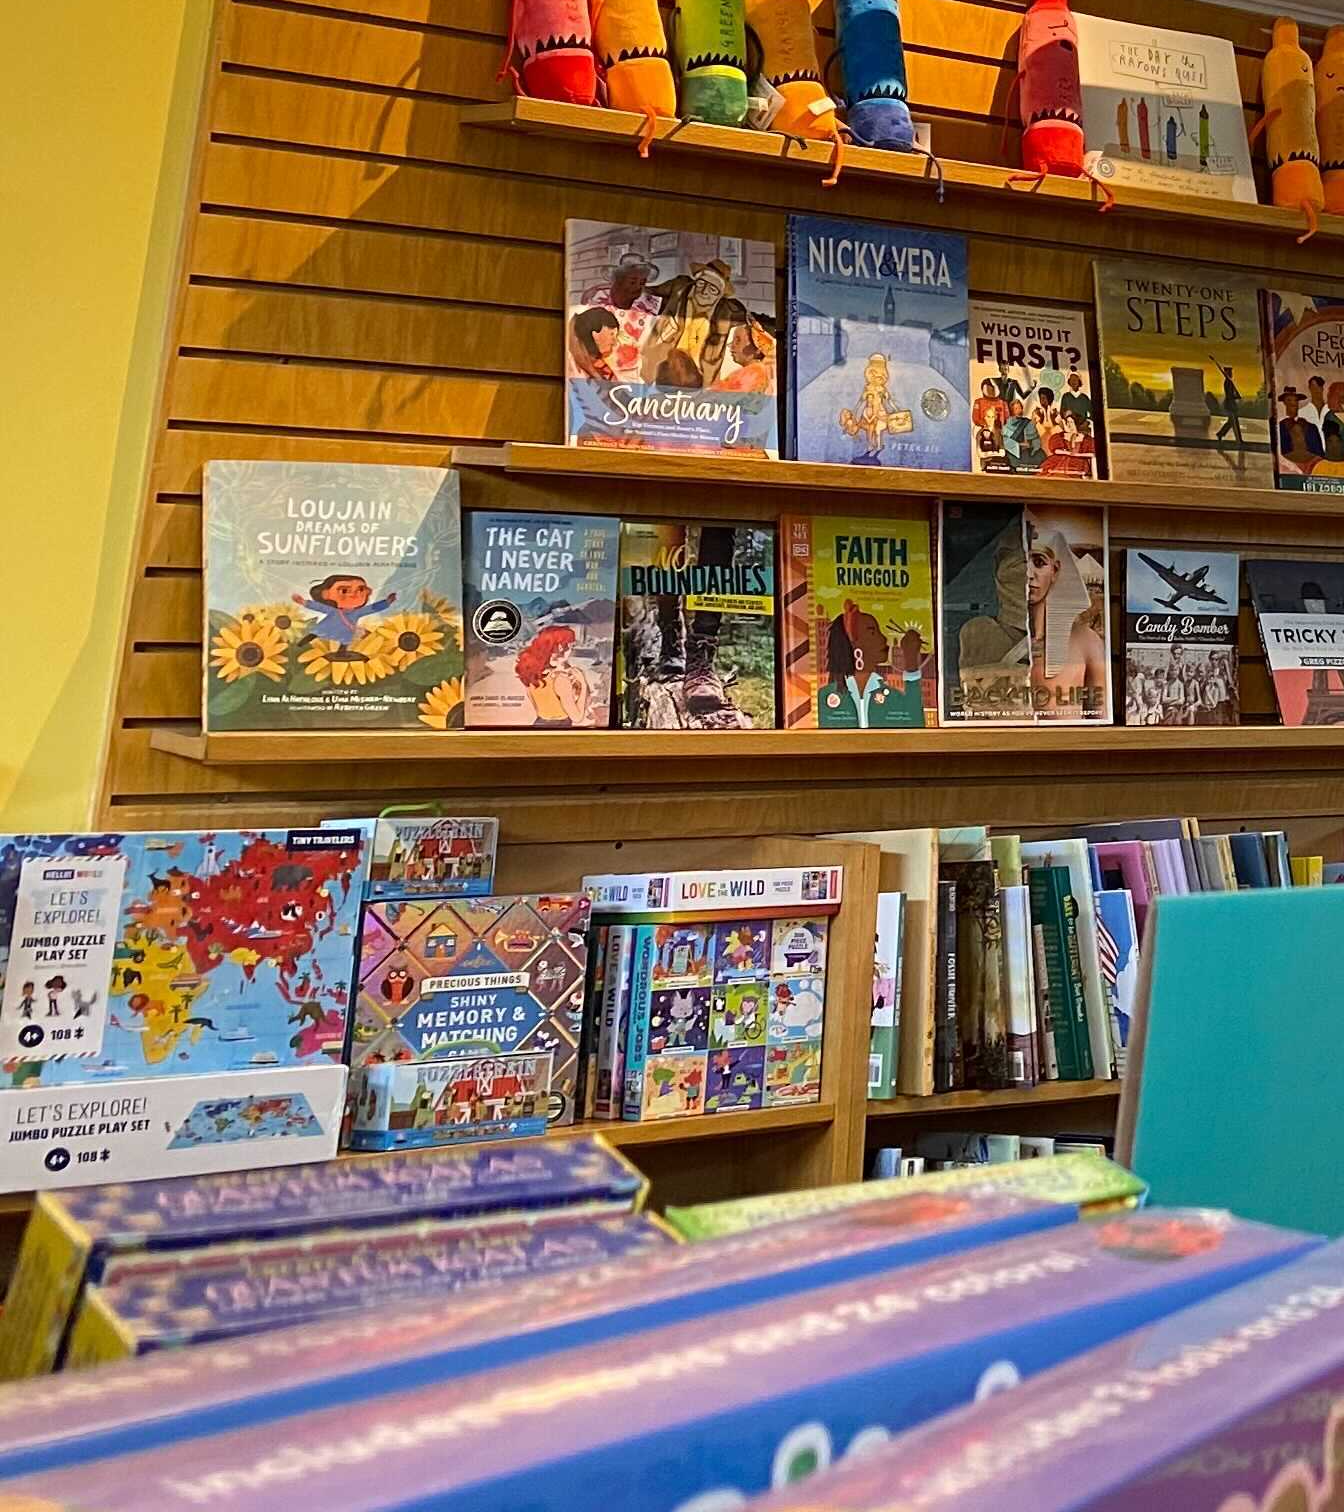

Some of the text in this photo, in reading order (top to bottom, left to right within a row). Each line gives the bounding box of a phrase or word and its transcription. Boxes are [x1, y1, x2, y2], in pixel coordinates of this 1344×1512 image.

[720, 0, 736, 49] GREEN
[808, 235, 885, 280] NICKY
[892, 245, 953, 289] VERA
[1124, 279, 1234, 303] TWENTY-ONE
[1126, 296, 1238, 342] STEPS
[981, 321, 1072, 343] WHO DID IT
[976, 338, 1082, 371] FIRST?
[603, 384, 745, 444] Sanctuary
[286, 497, 392, 521] LOUJAIN
[295, 521, 379, 534] DREAMS OF
[486, 527, 576, 549] THE CAT
[257, 531, 420, 558] SUNFLOWERS
[834, 535, 909, 566] FAITH
[485, 550, 574, 573] I NEVER
[481, 571, 560, 593] NAMED
[630, 564, 767, 596] BOUNDARIES
[836, 567, 911, 588] RINGGOLD
[1135, 615, 1231, 643] Candy Bomber
[1270, 627, 1337, 645] TRICKY
[49, 890, 89, 907] LET'S
[20, 933, 107, 949] JUMBO PUZZLE
[35, 948, 88, 962] PLAY SET
[429, 974, 523, 990] PRECIOUS THINGS
[450, 994, 497, 1008] SHINY
[416, 1006, 526, 1029] MEMORY &
[9, 1120, 151, 1143] JUMBO PUZZLE PLAY SET
